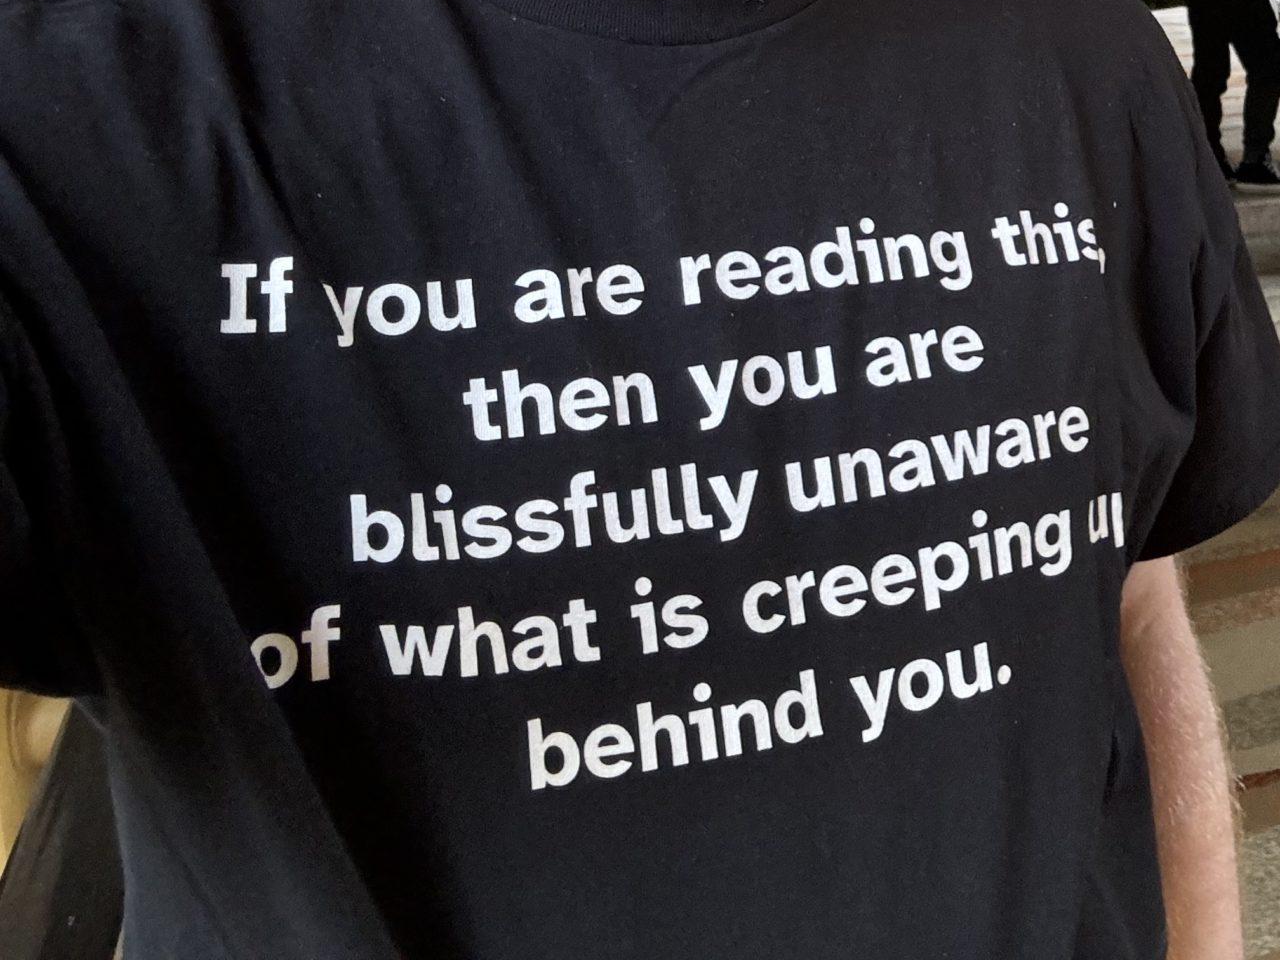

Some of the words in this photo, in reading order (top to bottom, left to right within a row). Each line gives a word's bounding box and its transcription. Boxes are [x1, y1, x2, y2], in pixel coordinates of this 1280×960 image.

[220, 255, 294, 334] If
[322, 278, 477, 348] you
[513, 263, 645, 324] are
[679, 217, 973, 306] reading
[462, 368, 659, 442] then
[687, 345, 838, 431] you
[864, 325, 985, 388] are
[349, 462, 759, 564] blissfully
[784, 405, 1090, 513] unaware
[250, 604, 342, 690] of
[378, 598, 601, 678] what
[630, 576, 710, 655] is
[741, 509, 1073, 635] creeping
[526, 682, 824, 791] behind
[848, 641, 1013, 743] you.
